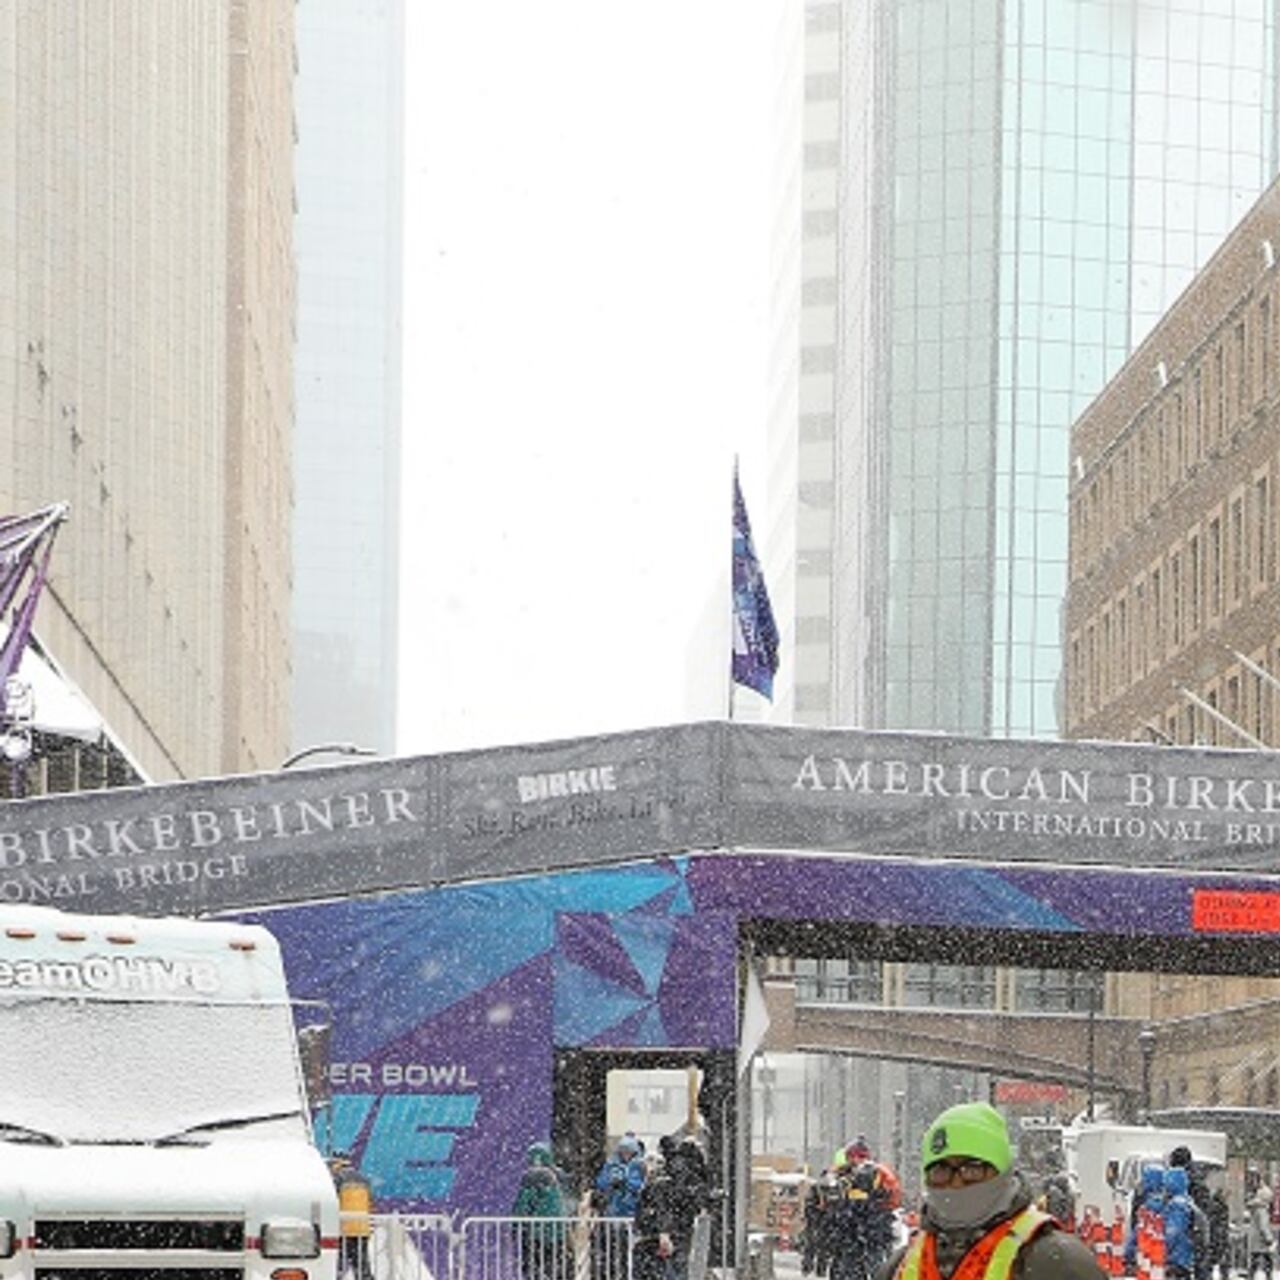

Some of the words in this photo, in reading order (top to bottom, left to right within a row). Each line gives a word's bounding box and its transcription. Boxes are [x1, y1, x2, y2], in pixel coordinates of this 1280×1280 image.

[518, 765, 617, 803] BIRKIE
[792, 754, 1092, 806] AMERICAN
[0, 788, 418, 870] BIRKEBEINER
[956, 809, 1208, 842] INTERNATIONAL
[113, 854, 249, 890] BRIDGE
[321, 1063, 371, 1084] ER
[382, 1065, 477, 1088] BOWL
